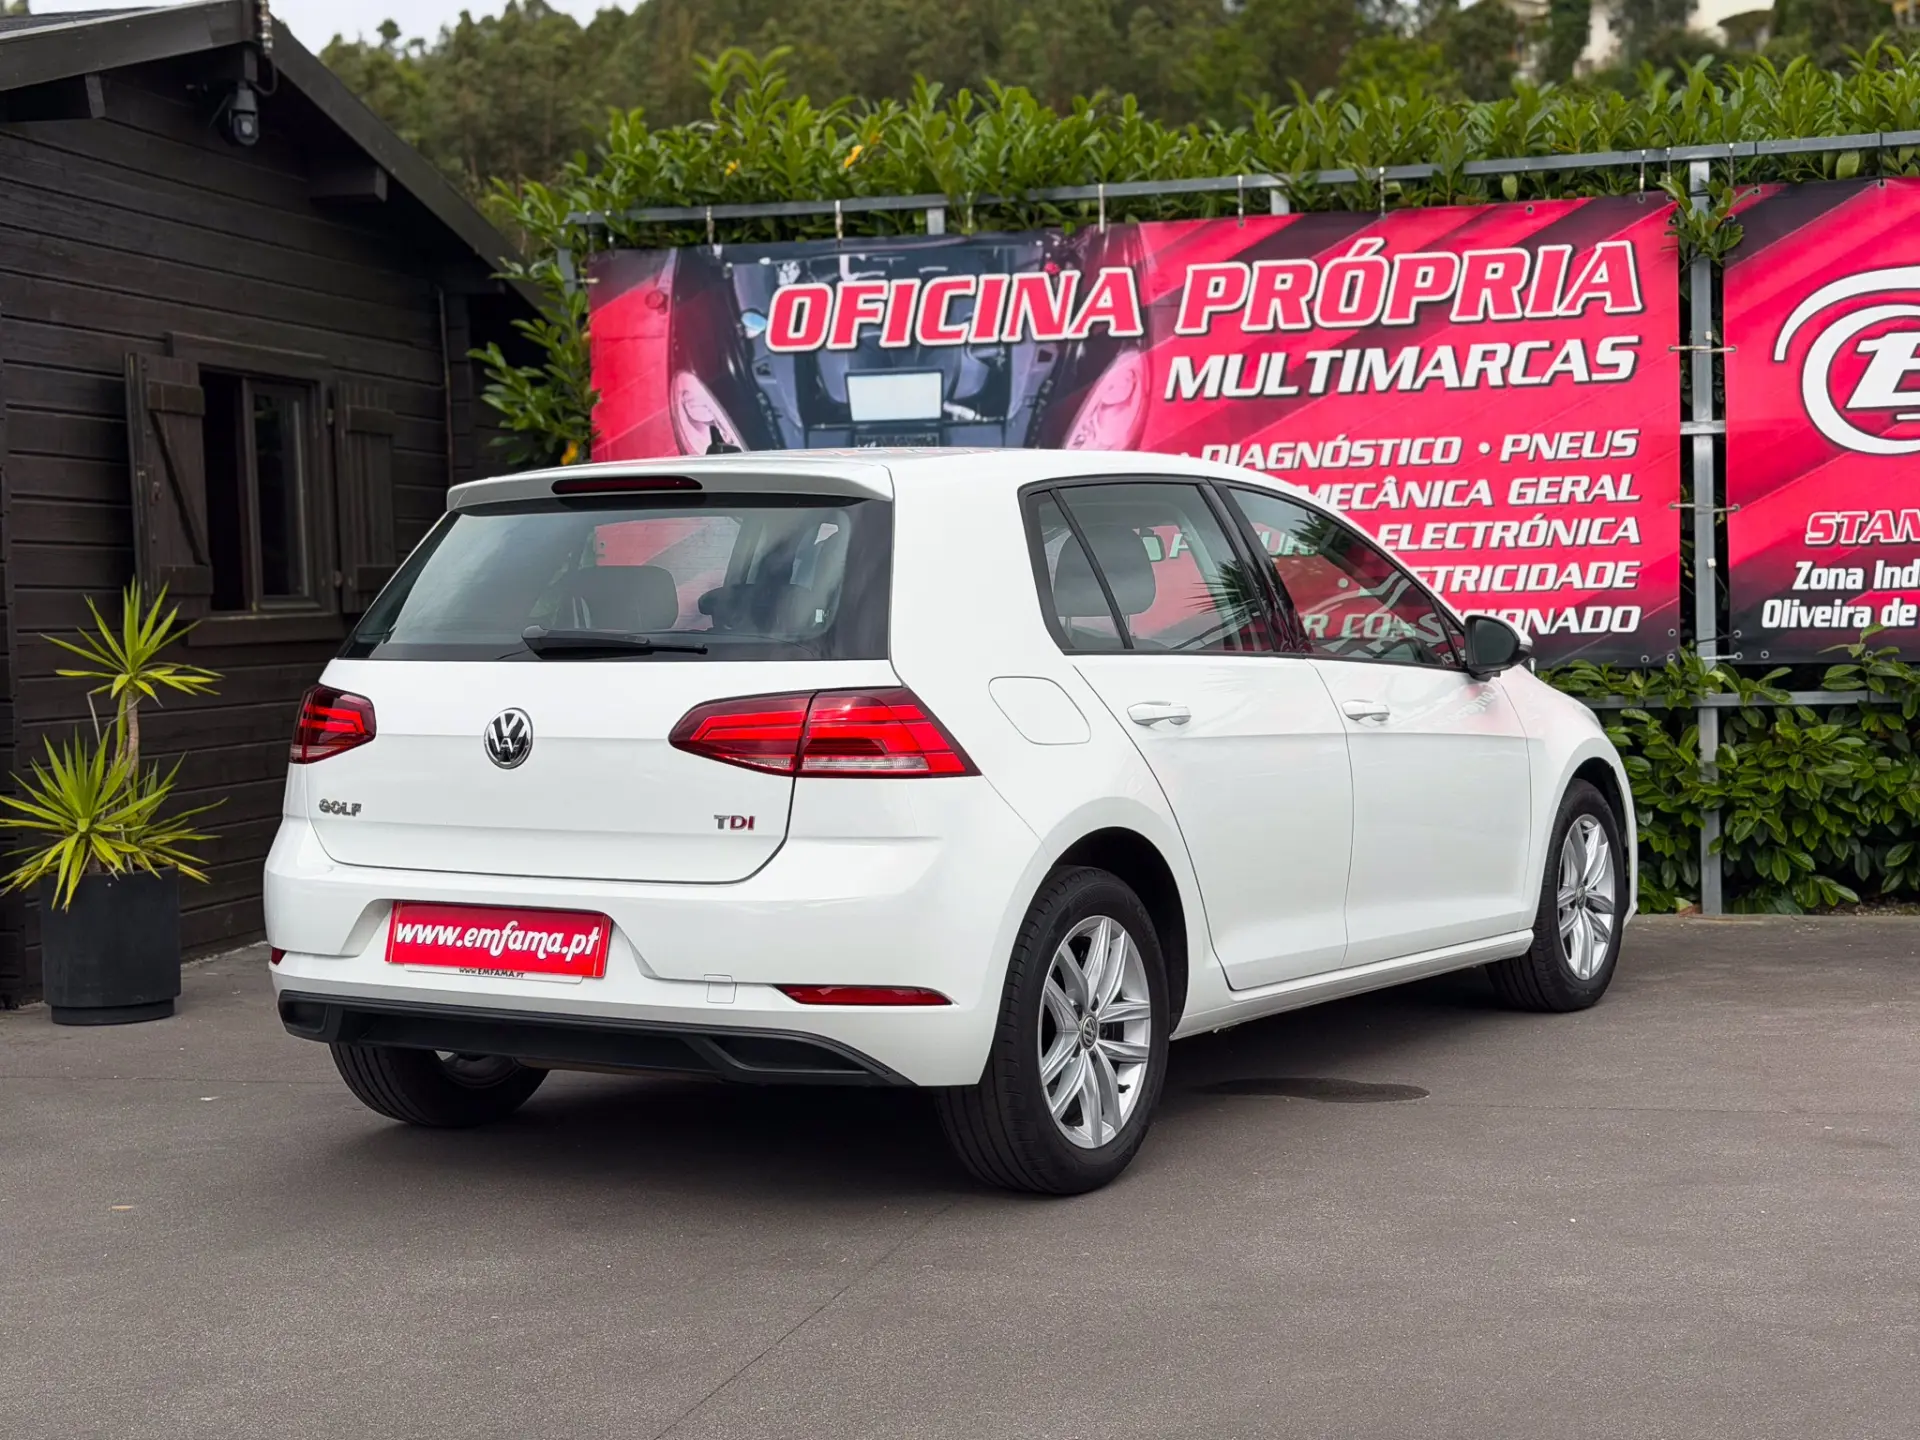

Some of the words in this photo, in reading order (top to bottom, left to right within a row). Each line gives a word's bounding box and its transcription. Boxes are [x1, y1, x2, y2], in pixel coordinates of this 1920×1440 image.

[765, 266, 1144, 352] OFICINA
[1175, 237, 1643, 335] PRÓPRIA
[1164, 336, 1641, 400] MULTIMARCAS
[1201, 434, 1462, 470] DIAGNÓSTICO
[1500, 429, 1640, 462] PNEUS
[1507, 473, 1641, 504] GERAL
[1377, 513, 1641, 551] ELECTRÓNICA
[1792, 561, 1865, 590] Zona
[1873, 559, 1920, 589] Ind
[1762, 599, 1872, 628] Oliveira
[1880, 598, 1918, 627] de
[318, 798, 362, 817] GOLF
[713, 814, 756, 831] TDI
[396, 920, 600, 962] www.emfama.pt
